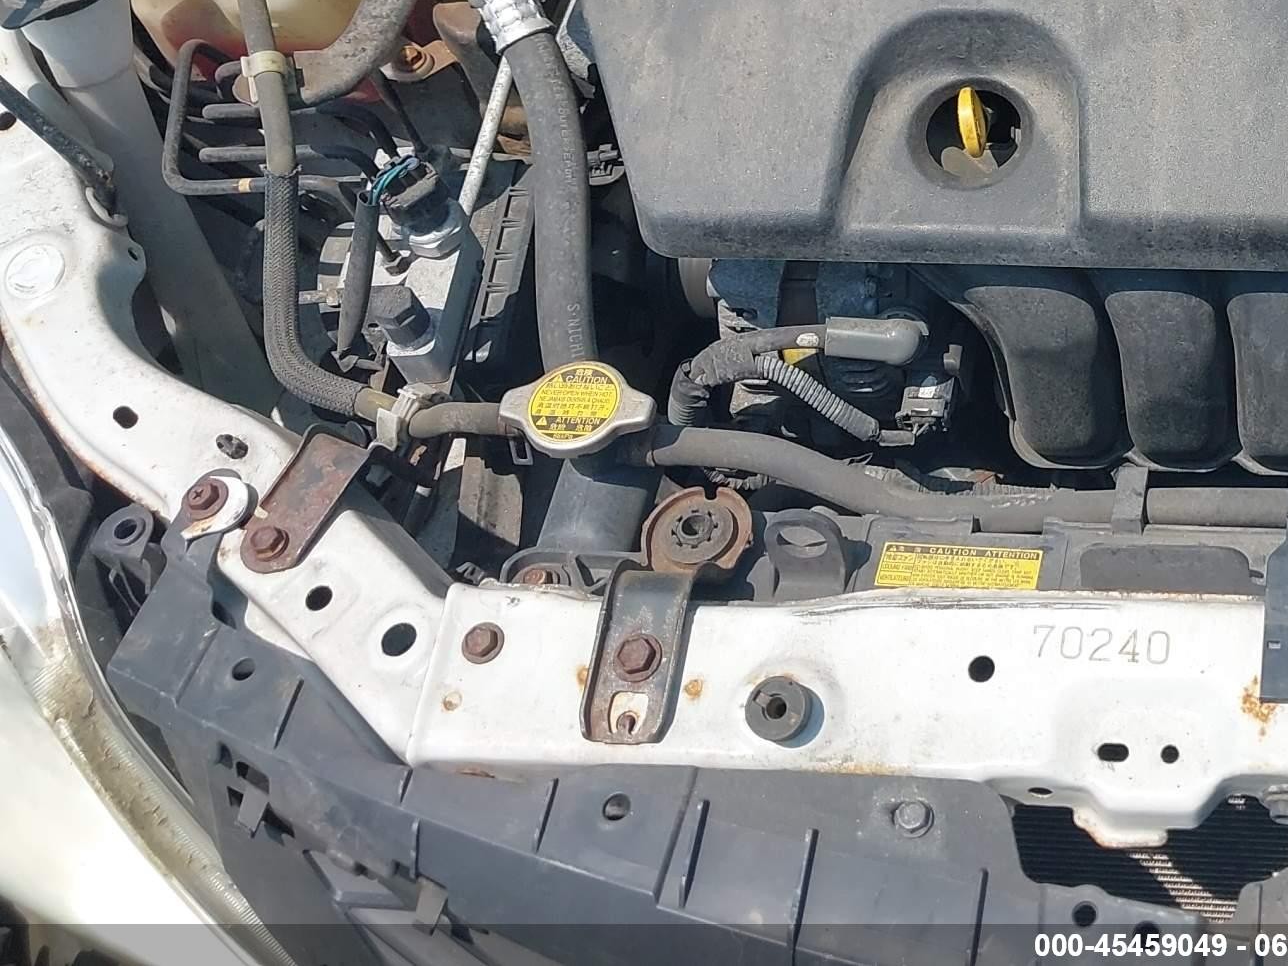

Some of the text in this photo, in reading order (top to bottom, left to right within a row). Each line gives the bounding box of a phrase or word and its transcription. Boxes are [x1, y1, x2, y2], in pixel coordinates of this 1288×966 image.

[566, 376, 608, 384] CAUTION
[929, 547, 977, 556] CAUTION
[984, 550, 1038, 560] ATTENTION
[1032, 624, 1171, 665] 70240
